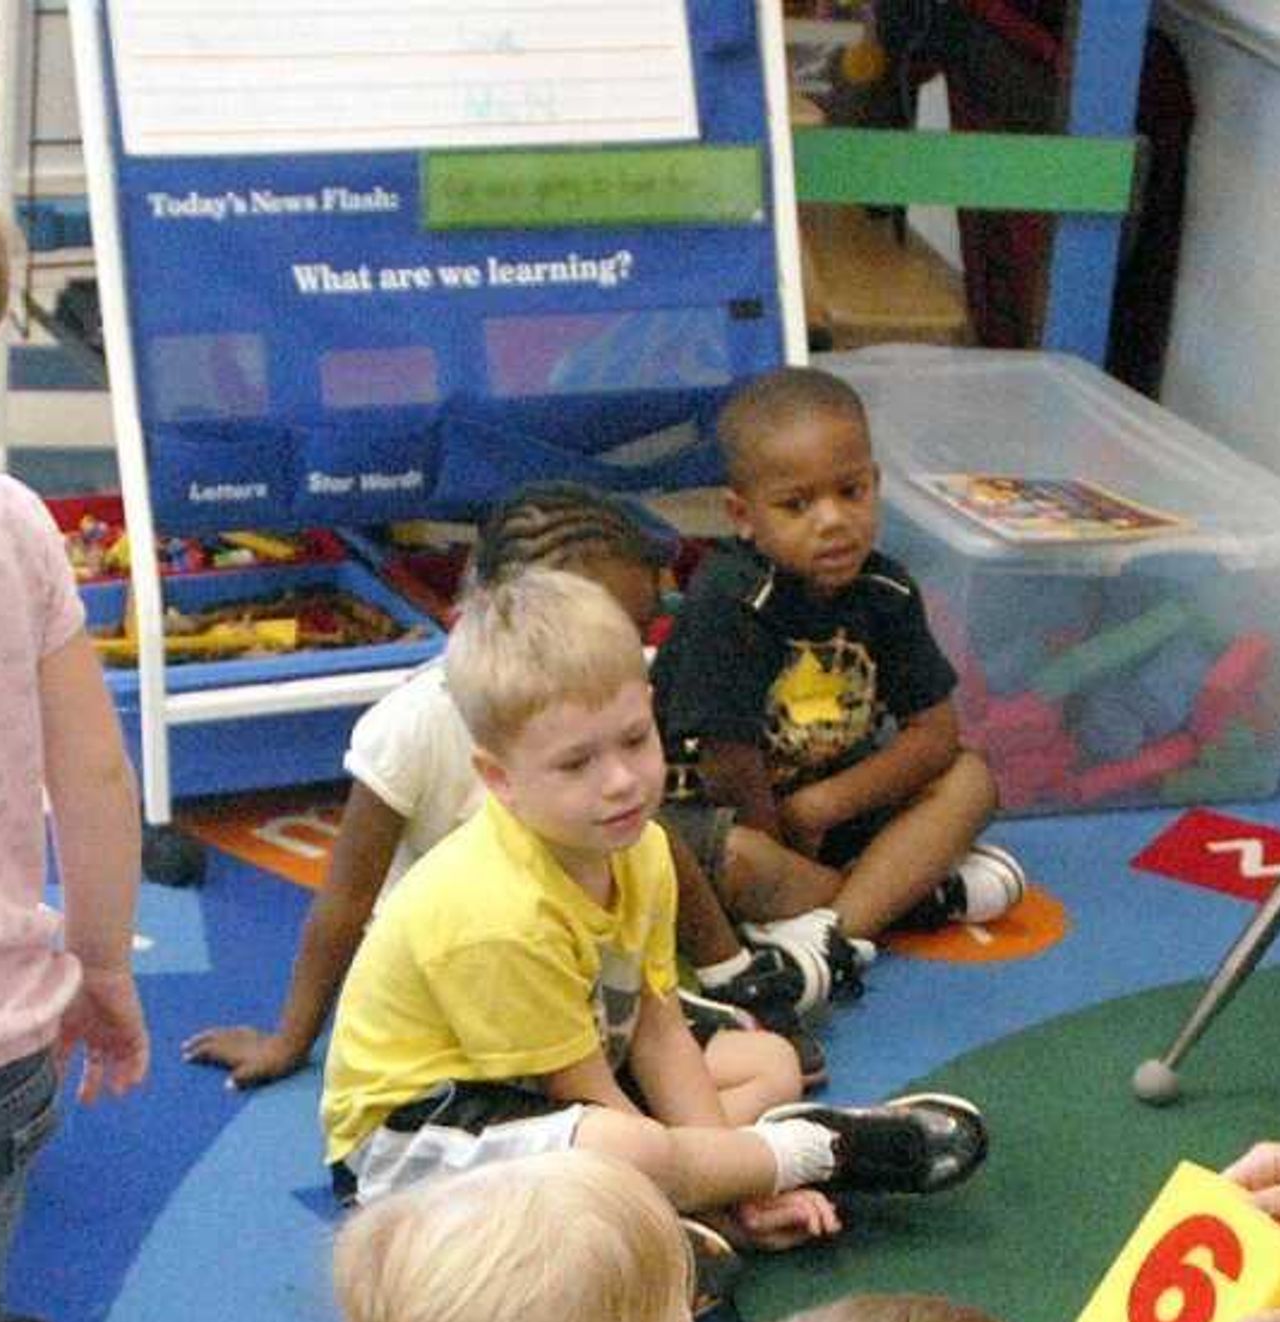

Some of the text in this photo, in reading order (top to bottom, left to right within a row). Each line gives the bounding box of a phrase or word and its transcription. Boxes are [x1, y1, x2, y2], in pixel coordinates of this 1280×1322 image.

[147, 186, 399, 221] Today's News Flash:
[292, 249, 633, 293] What are we learning?
